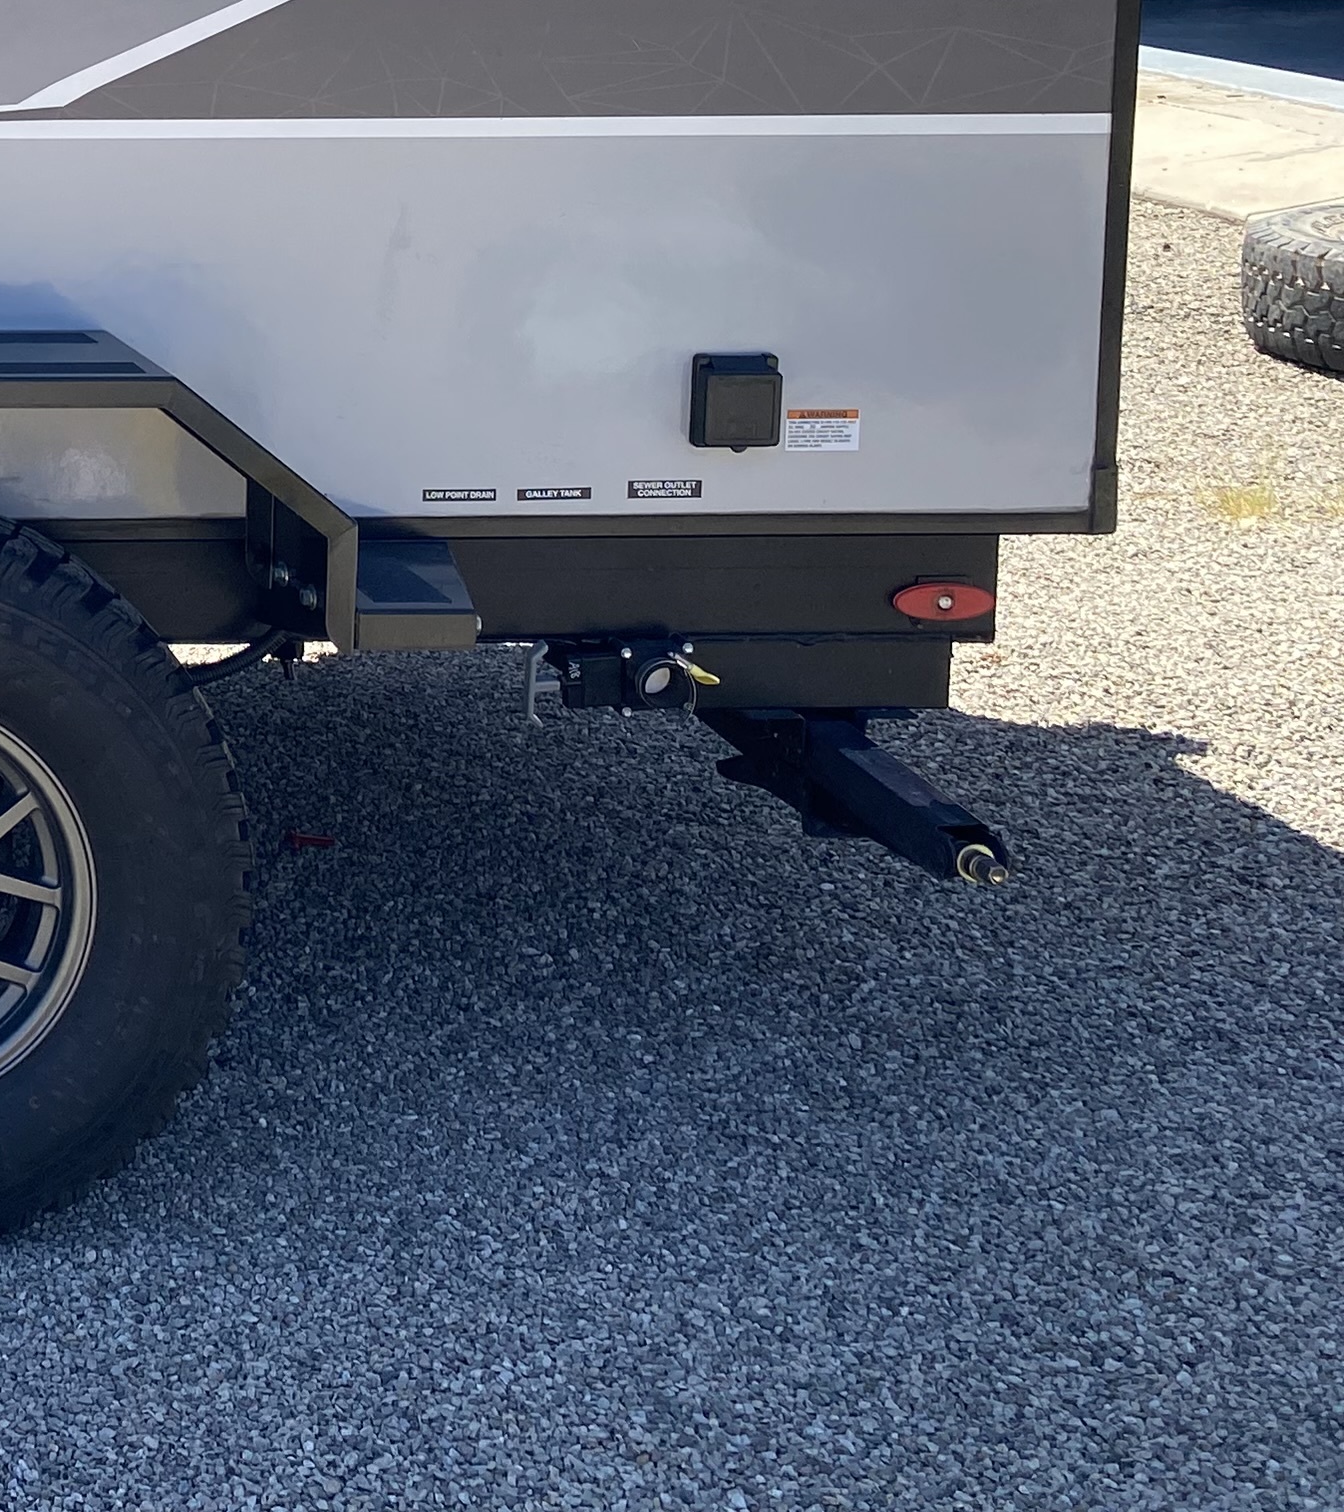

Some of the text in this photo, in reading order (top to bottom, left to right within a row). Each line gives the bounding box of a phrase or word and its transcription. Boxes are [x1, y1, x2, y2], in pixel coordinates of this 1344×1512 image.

[633, 481, 697, 489] SEWER OUTLET
[425, 490, 494, 499] LOW POINT DRAIN
[525, 489, 582, 498] GALLEY TANK
[637, 489, 692, 497] CONNECTION
